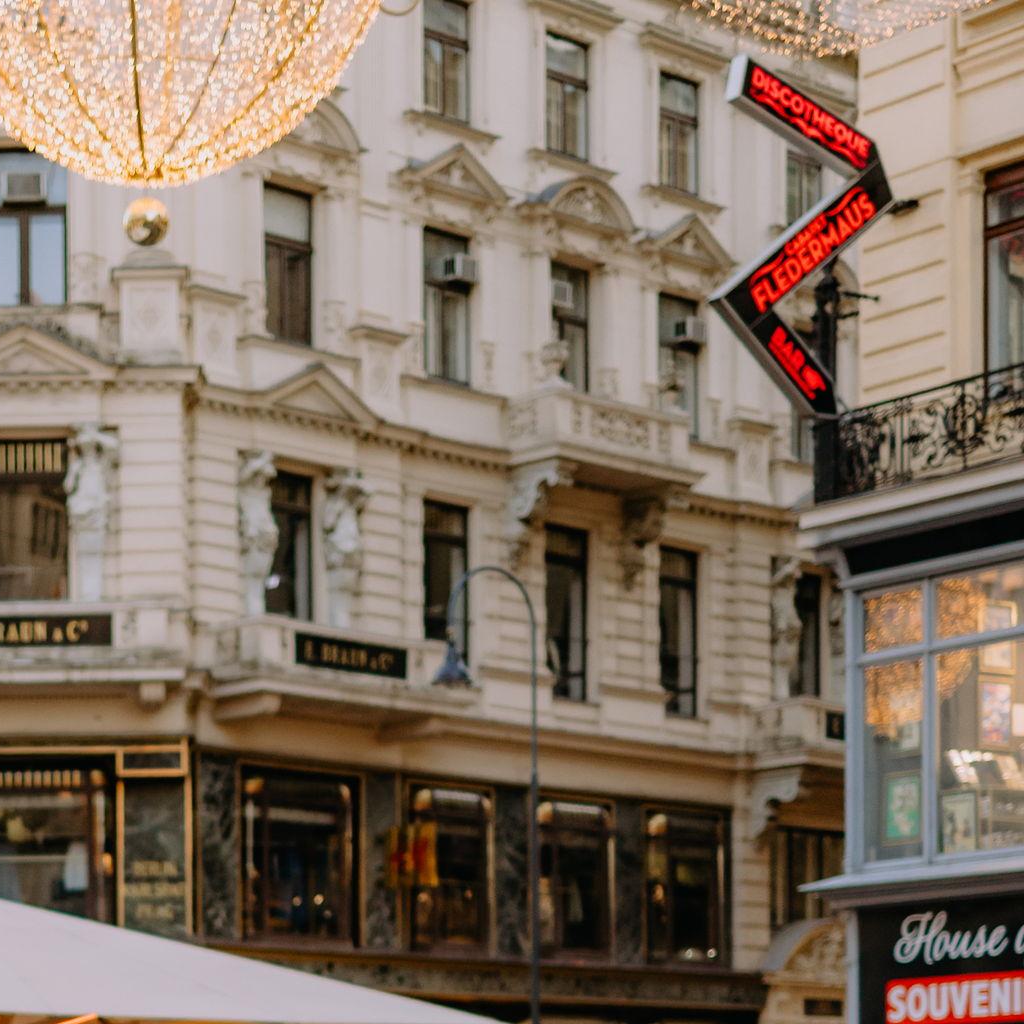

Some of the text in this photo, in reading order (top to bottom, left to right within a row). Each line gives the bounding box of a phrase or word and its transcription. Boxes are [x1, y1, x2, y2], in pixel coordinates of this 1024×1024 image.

[751, 65, 872, 160] DISCOTHEQUE
[750, 191, 876, 314] FLEDERMAUS
[893, 910, 1010, 966] House
